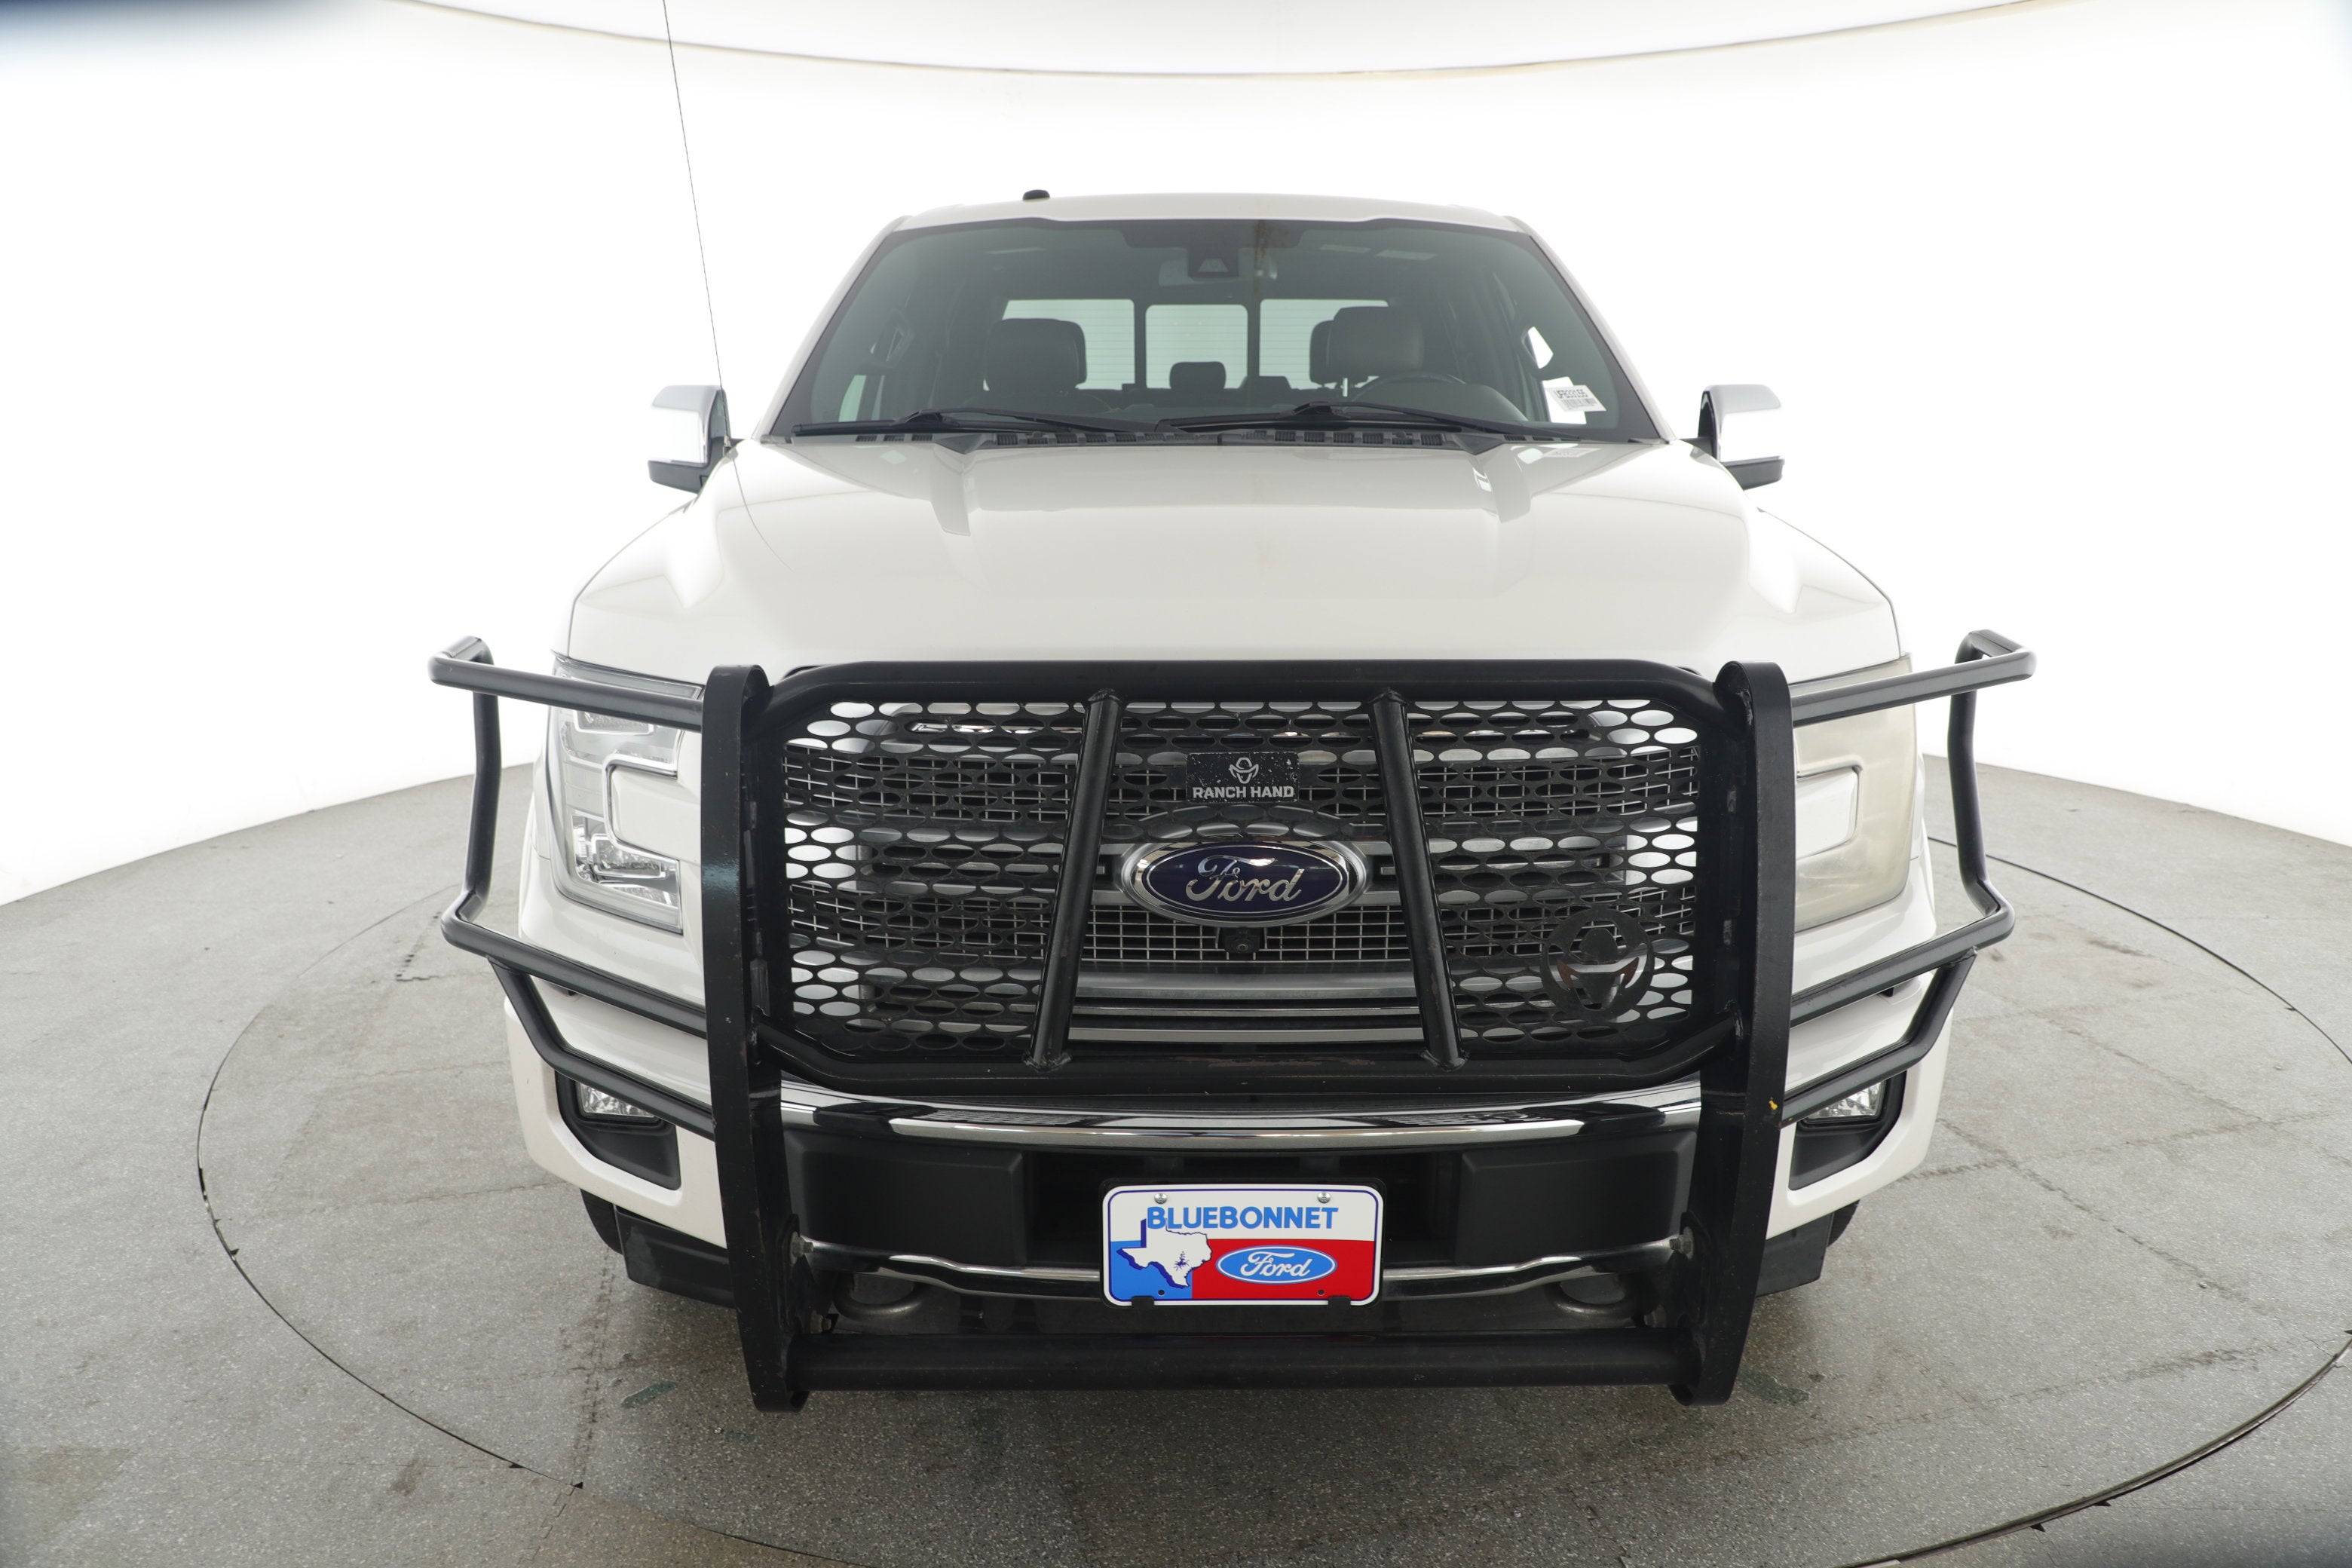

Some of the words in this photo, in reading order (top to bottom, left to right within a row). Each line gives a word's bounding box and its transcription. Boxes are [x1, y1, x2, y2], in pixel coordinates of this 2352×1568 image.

[1193, 786, 1247, 798] RANCH
[1251, 786, 1295, 798] HAND
[1185, 855, 1305, 902] Ford
[1146, 1205, 1339, 1230] BLUEBONNET
[1239, 1249, 1312, 1278] Ford
